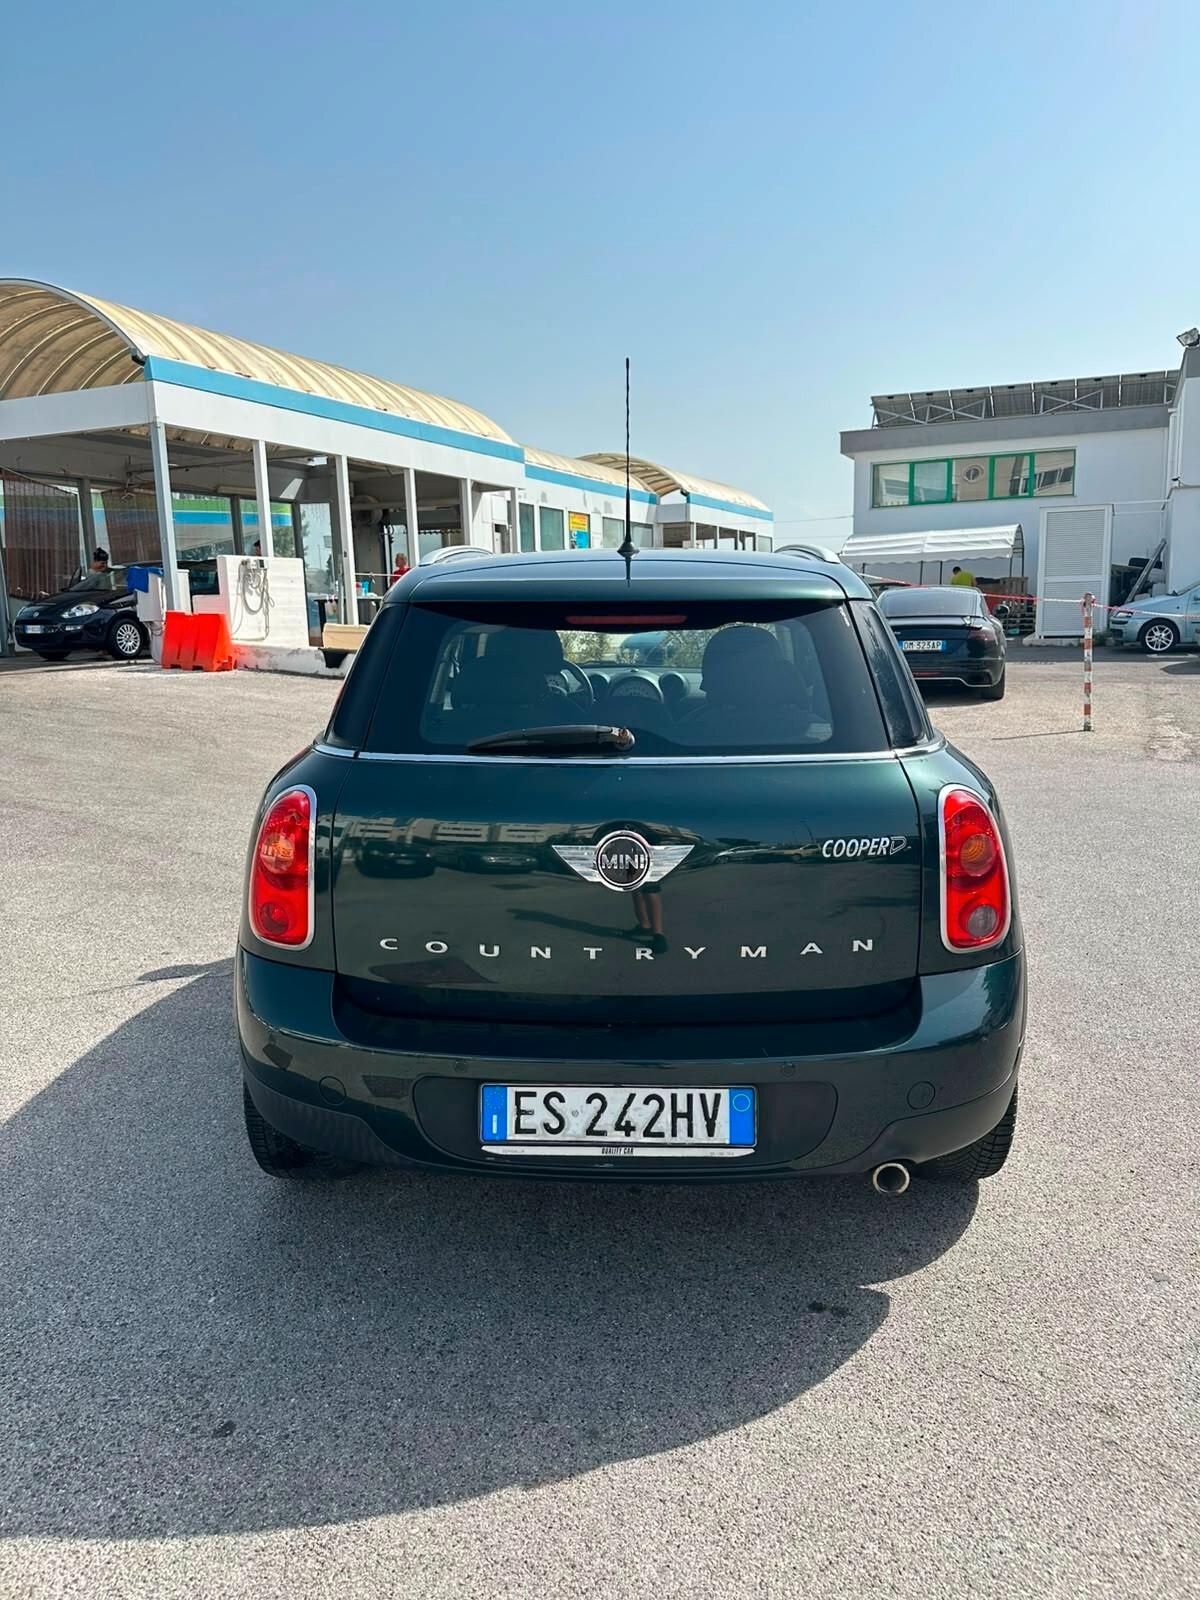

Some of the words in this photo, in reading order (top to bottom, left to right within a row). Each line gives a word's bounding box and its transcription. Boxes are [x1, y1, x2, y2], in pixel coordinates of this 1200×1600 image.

[822, 837, 890, 858] COOPER
[601, 853, 645, 870] MINI
[380, 938, 875, 961] COUNTRYMAN
[514, 1091, 566, 1135] ES
[585, 1092, 722, 1138] 242HV
[601, 1147, 622, 1155] QUALITY
[623, 1147, 634, 1155] CAR
